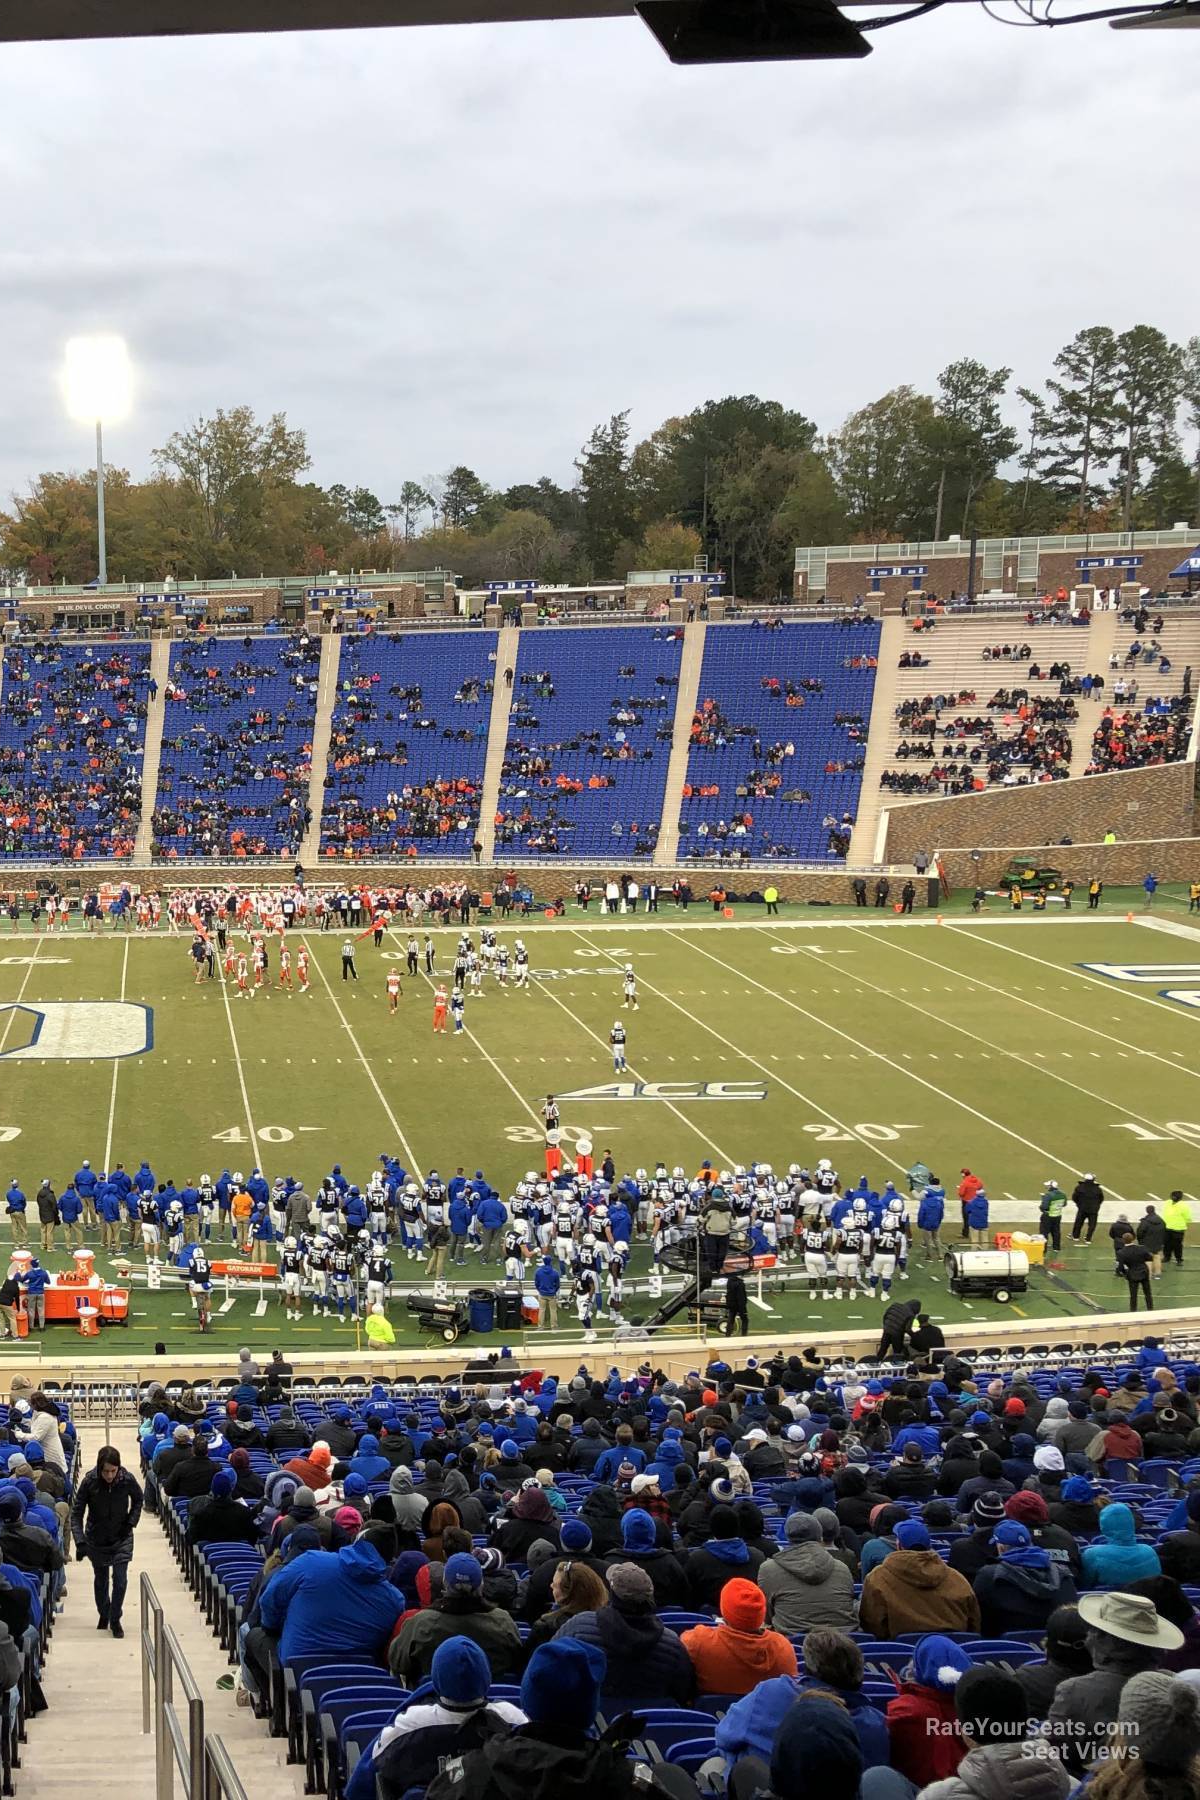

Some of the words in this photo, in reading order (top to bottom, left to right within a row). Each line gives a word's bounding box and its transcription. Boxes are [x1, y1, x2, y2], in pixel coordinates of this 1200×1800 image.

[536, 1081, 768, 1101] ACC
[211, 1126, 295, 1143] 40
[801, 1123, 902, 1142] 20
[428, 1190, 440, 1200] 53
[372, 1196, 384, 1207] 34
[778, 1199, 792, 1210] 67
[760, 1208, 774, 1219] 75
[854, 1214, 868, 1226] 66
[807, 1236, 822, 1249] 68
[846, 1235, 860, 1248] 65
[878, 1236, 895, 1248] 76
[196, 1260, 207, 1273] 15
[335, 1259, 347, 1271] 81
